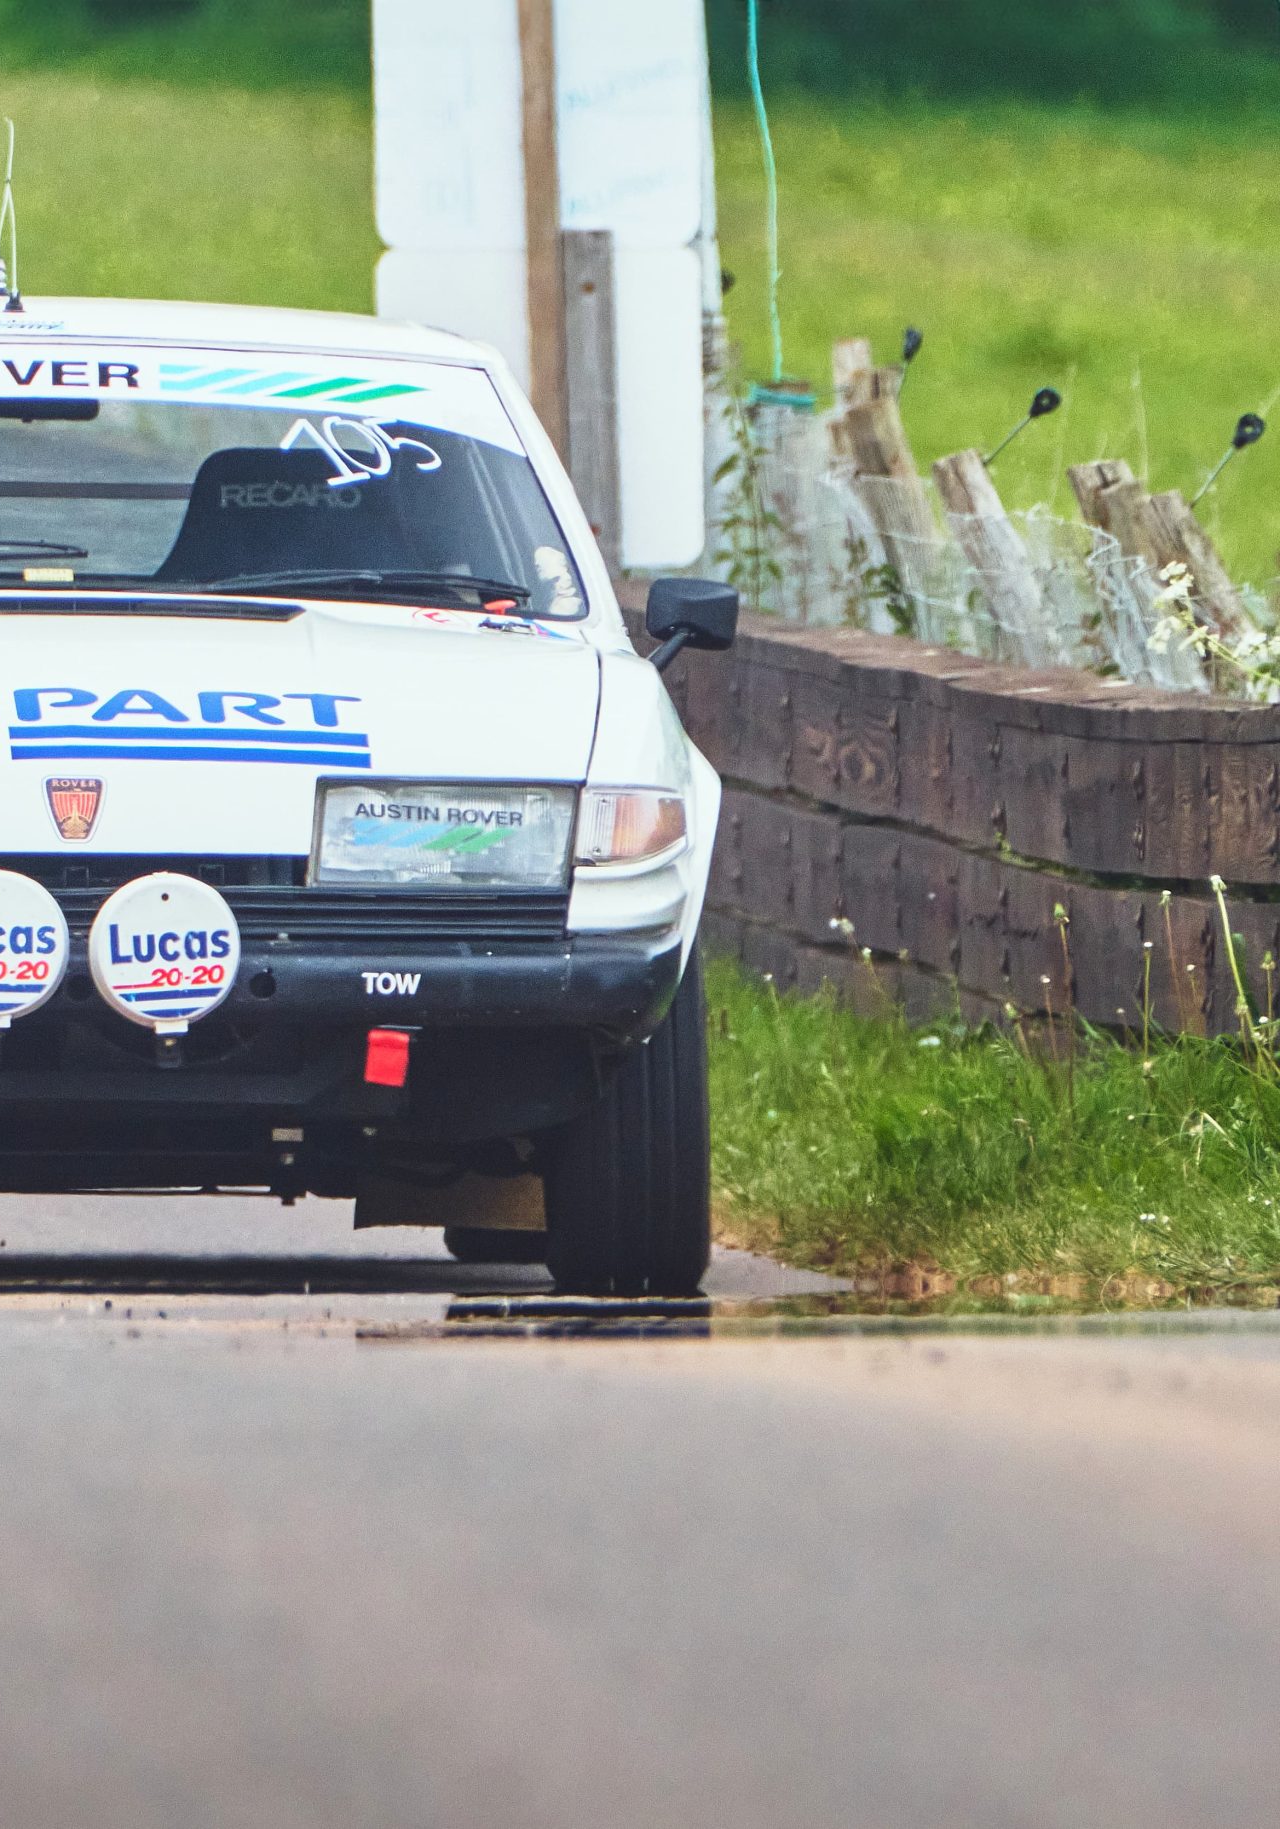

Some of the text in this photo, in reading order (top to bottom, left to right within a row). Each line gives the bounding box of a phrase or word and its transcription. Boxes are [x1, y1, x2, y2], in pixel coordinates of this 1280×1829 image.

[280, 416, 442, 486] 105
[52, 779, 97, 787] ROVER
[355, 803, 523, 826] AUSTIN ROVER
[109, 923, 230, 966] Lucas
[151, 965, 224, 987] 20-20
[361, 972, 421, 995] TOW
